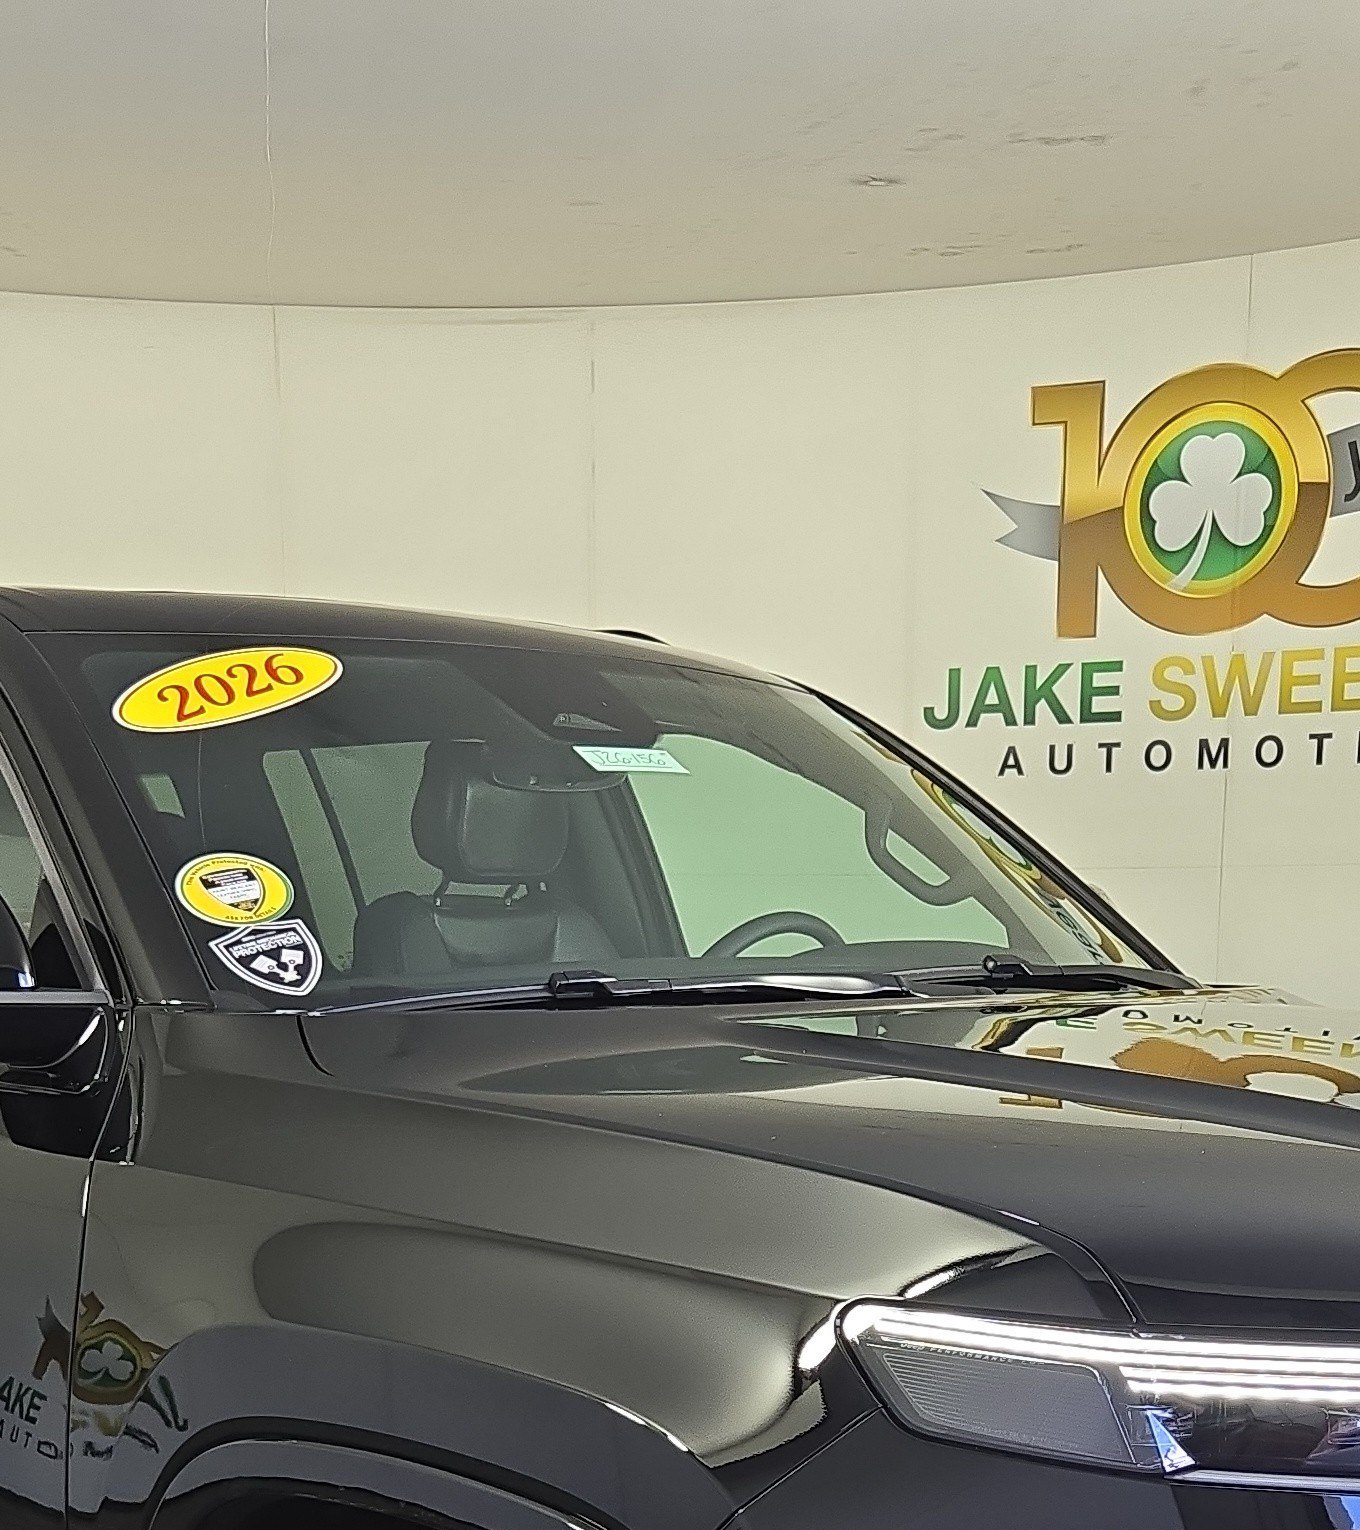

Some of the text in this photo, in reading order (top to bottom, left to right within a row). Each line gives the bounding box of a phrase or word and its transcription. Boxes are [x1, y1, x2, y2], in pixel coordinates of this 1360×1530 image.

[156, 653, 307, 723] 2026
[922, 659, 1125, 732] JAKE
[232, 934, 304, 959] PROTECTION
